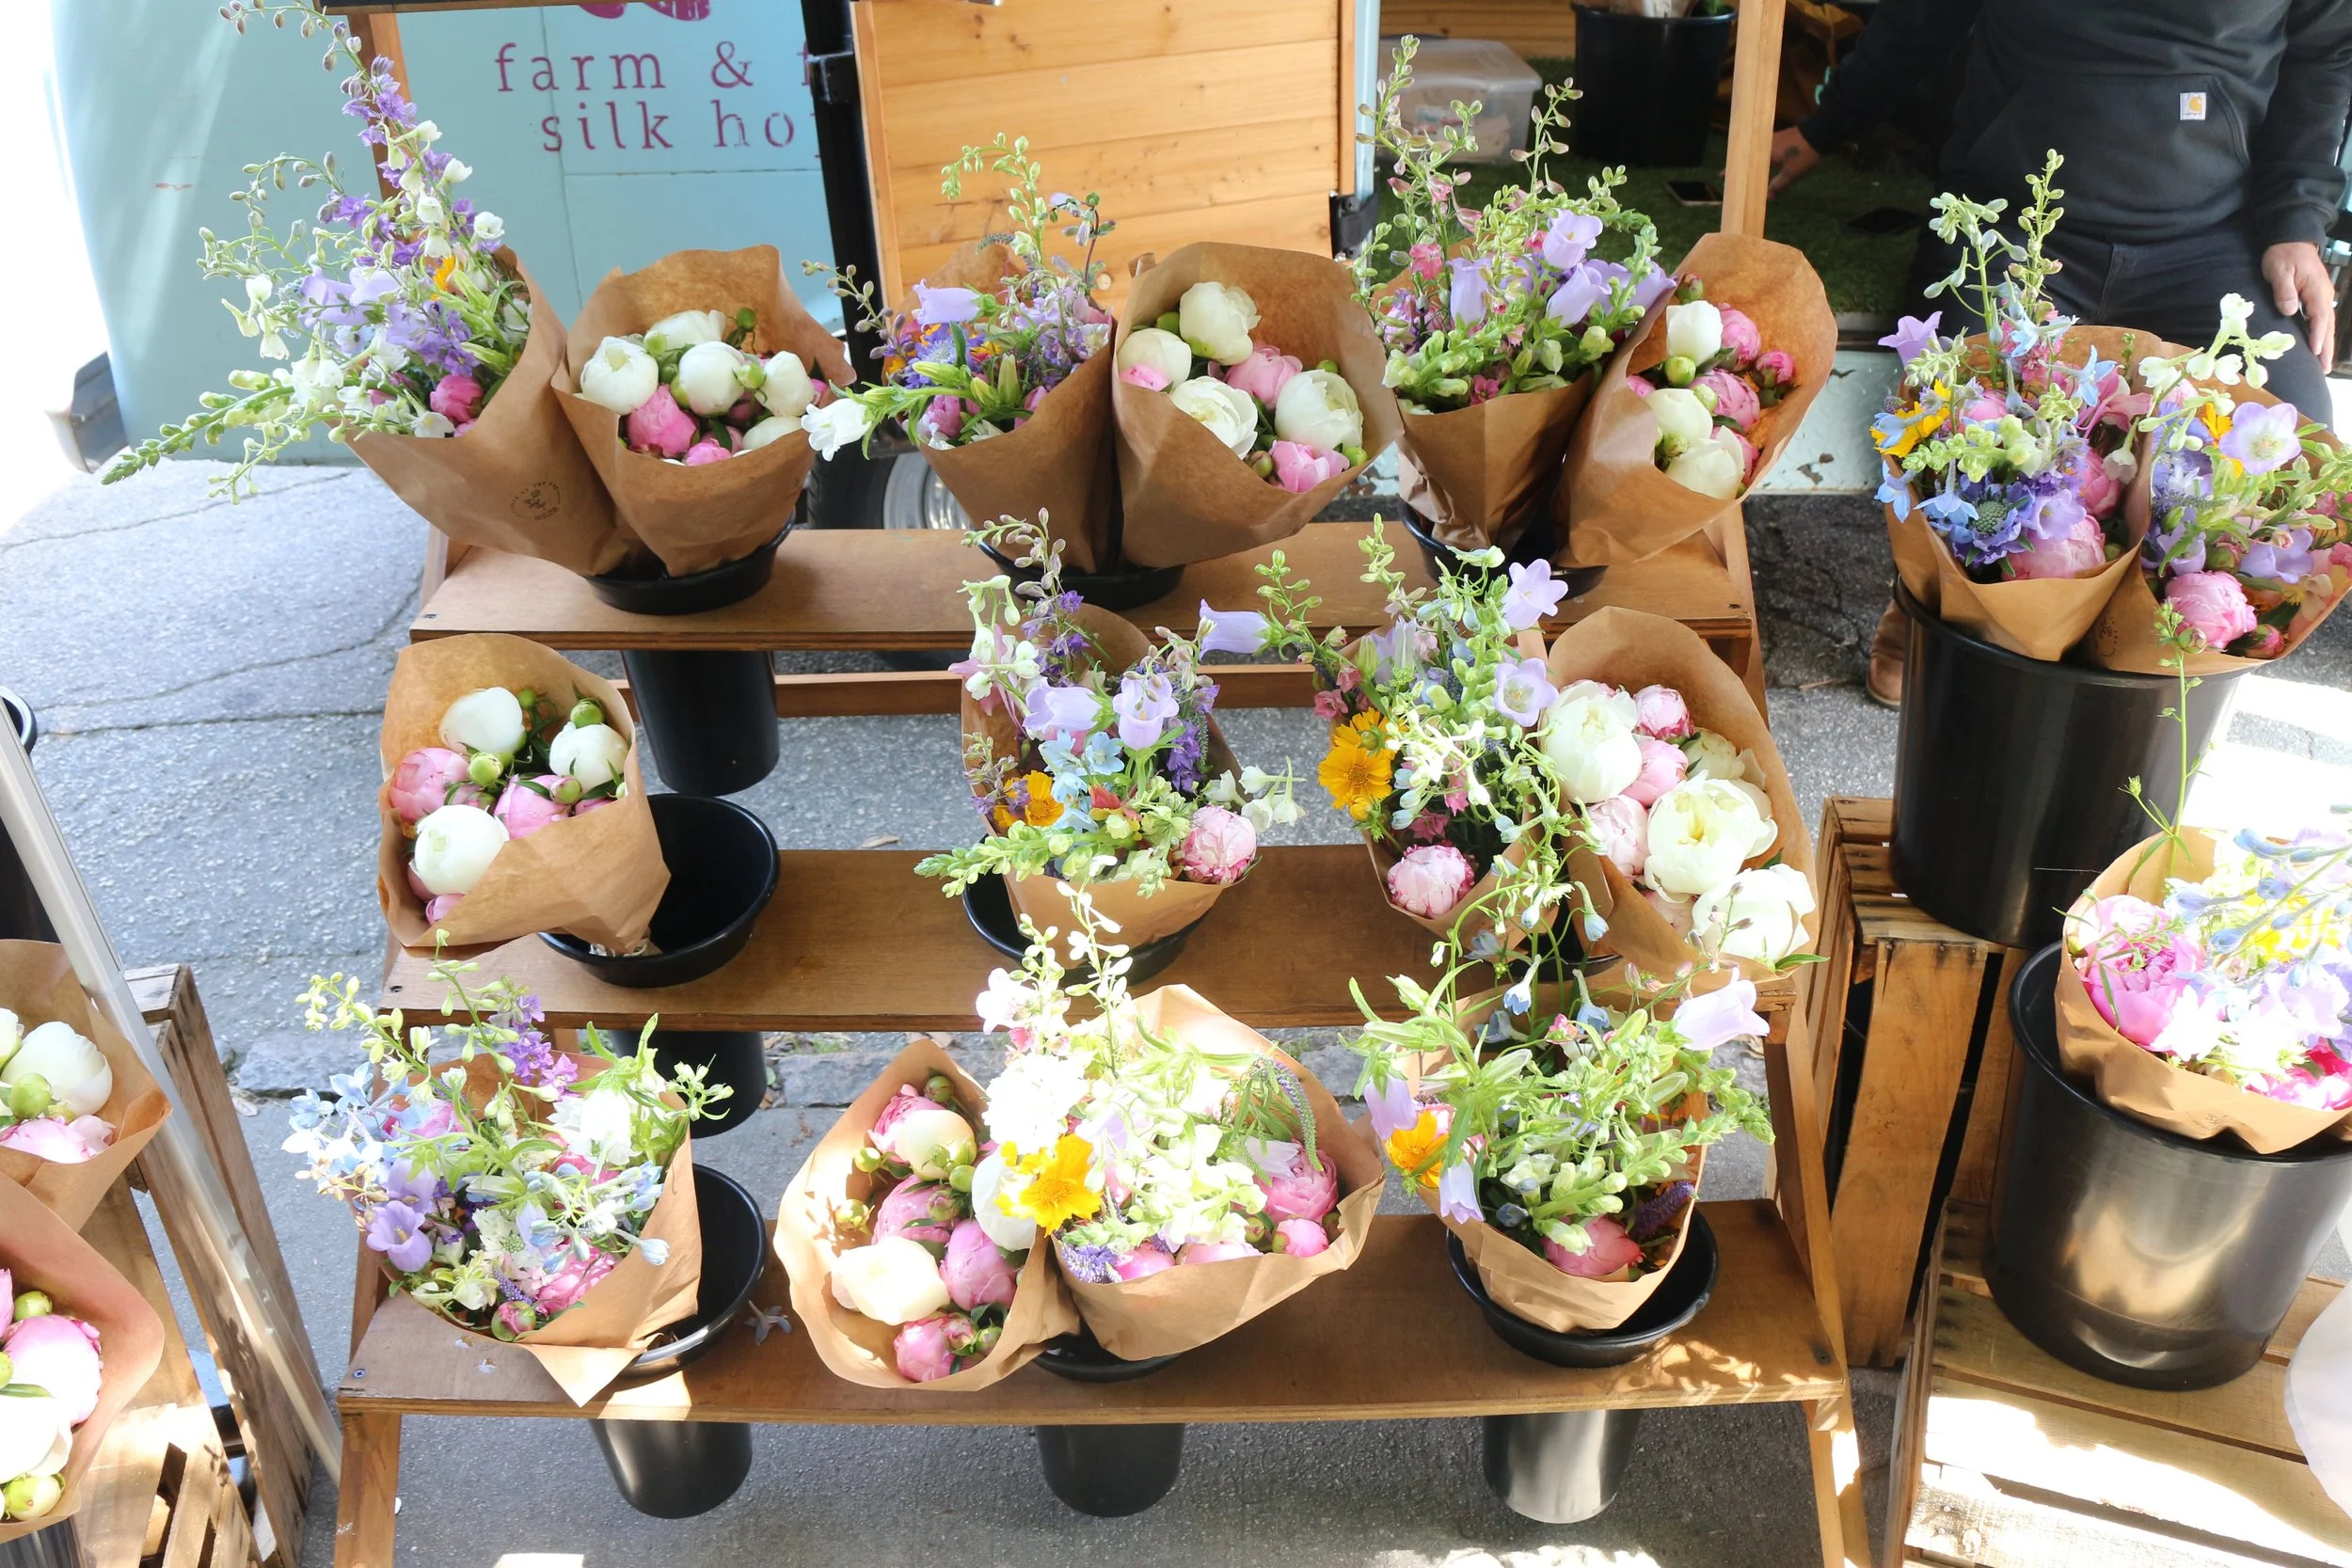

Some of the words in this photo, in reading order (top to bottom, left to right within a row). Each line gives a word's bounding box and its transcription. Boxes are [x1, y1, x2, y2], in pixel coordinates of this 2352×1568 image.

[495, 42, 666, 92] farm
[711, 40, 754, 88] &
[541, 101, 674, 151] silk
[711, 100, 819, 158] ho
